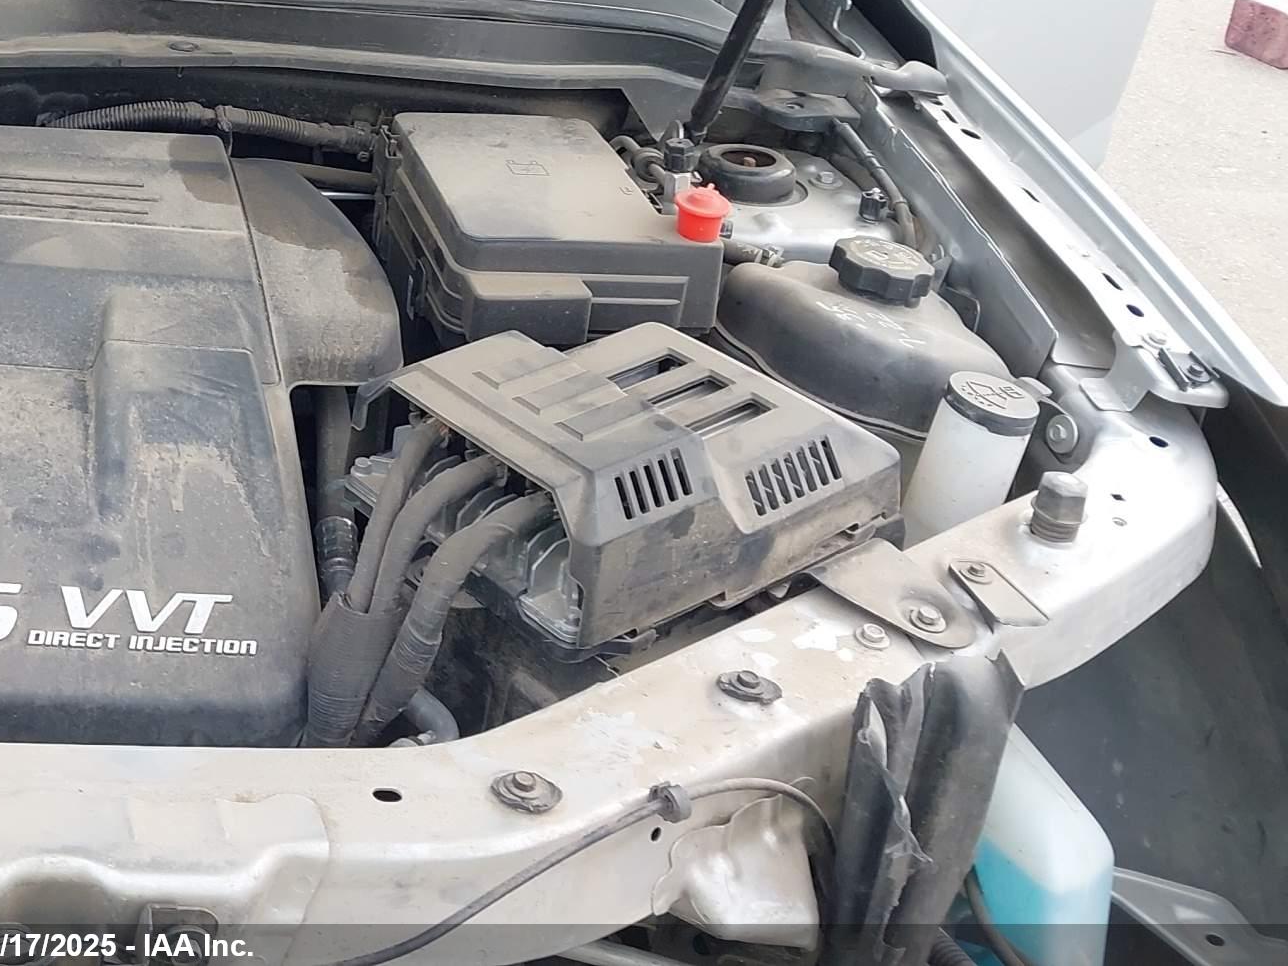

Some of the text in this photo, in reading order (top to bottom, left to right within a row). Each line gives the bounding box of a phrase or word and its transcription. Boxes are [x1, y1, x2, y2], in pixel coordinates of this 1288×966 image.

[60, 585, 233, 635] VVT
[27, 630, 258, 655] DIRECT INJECTION
